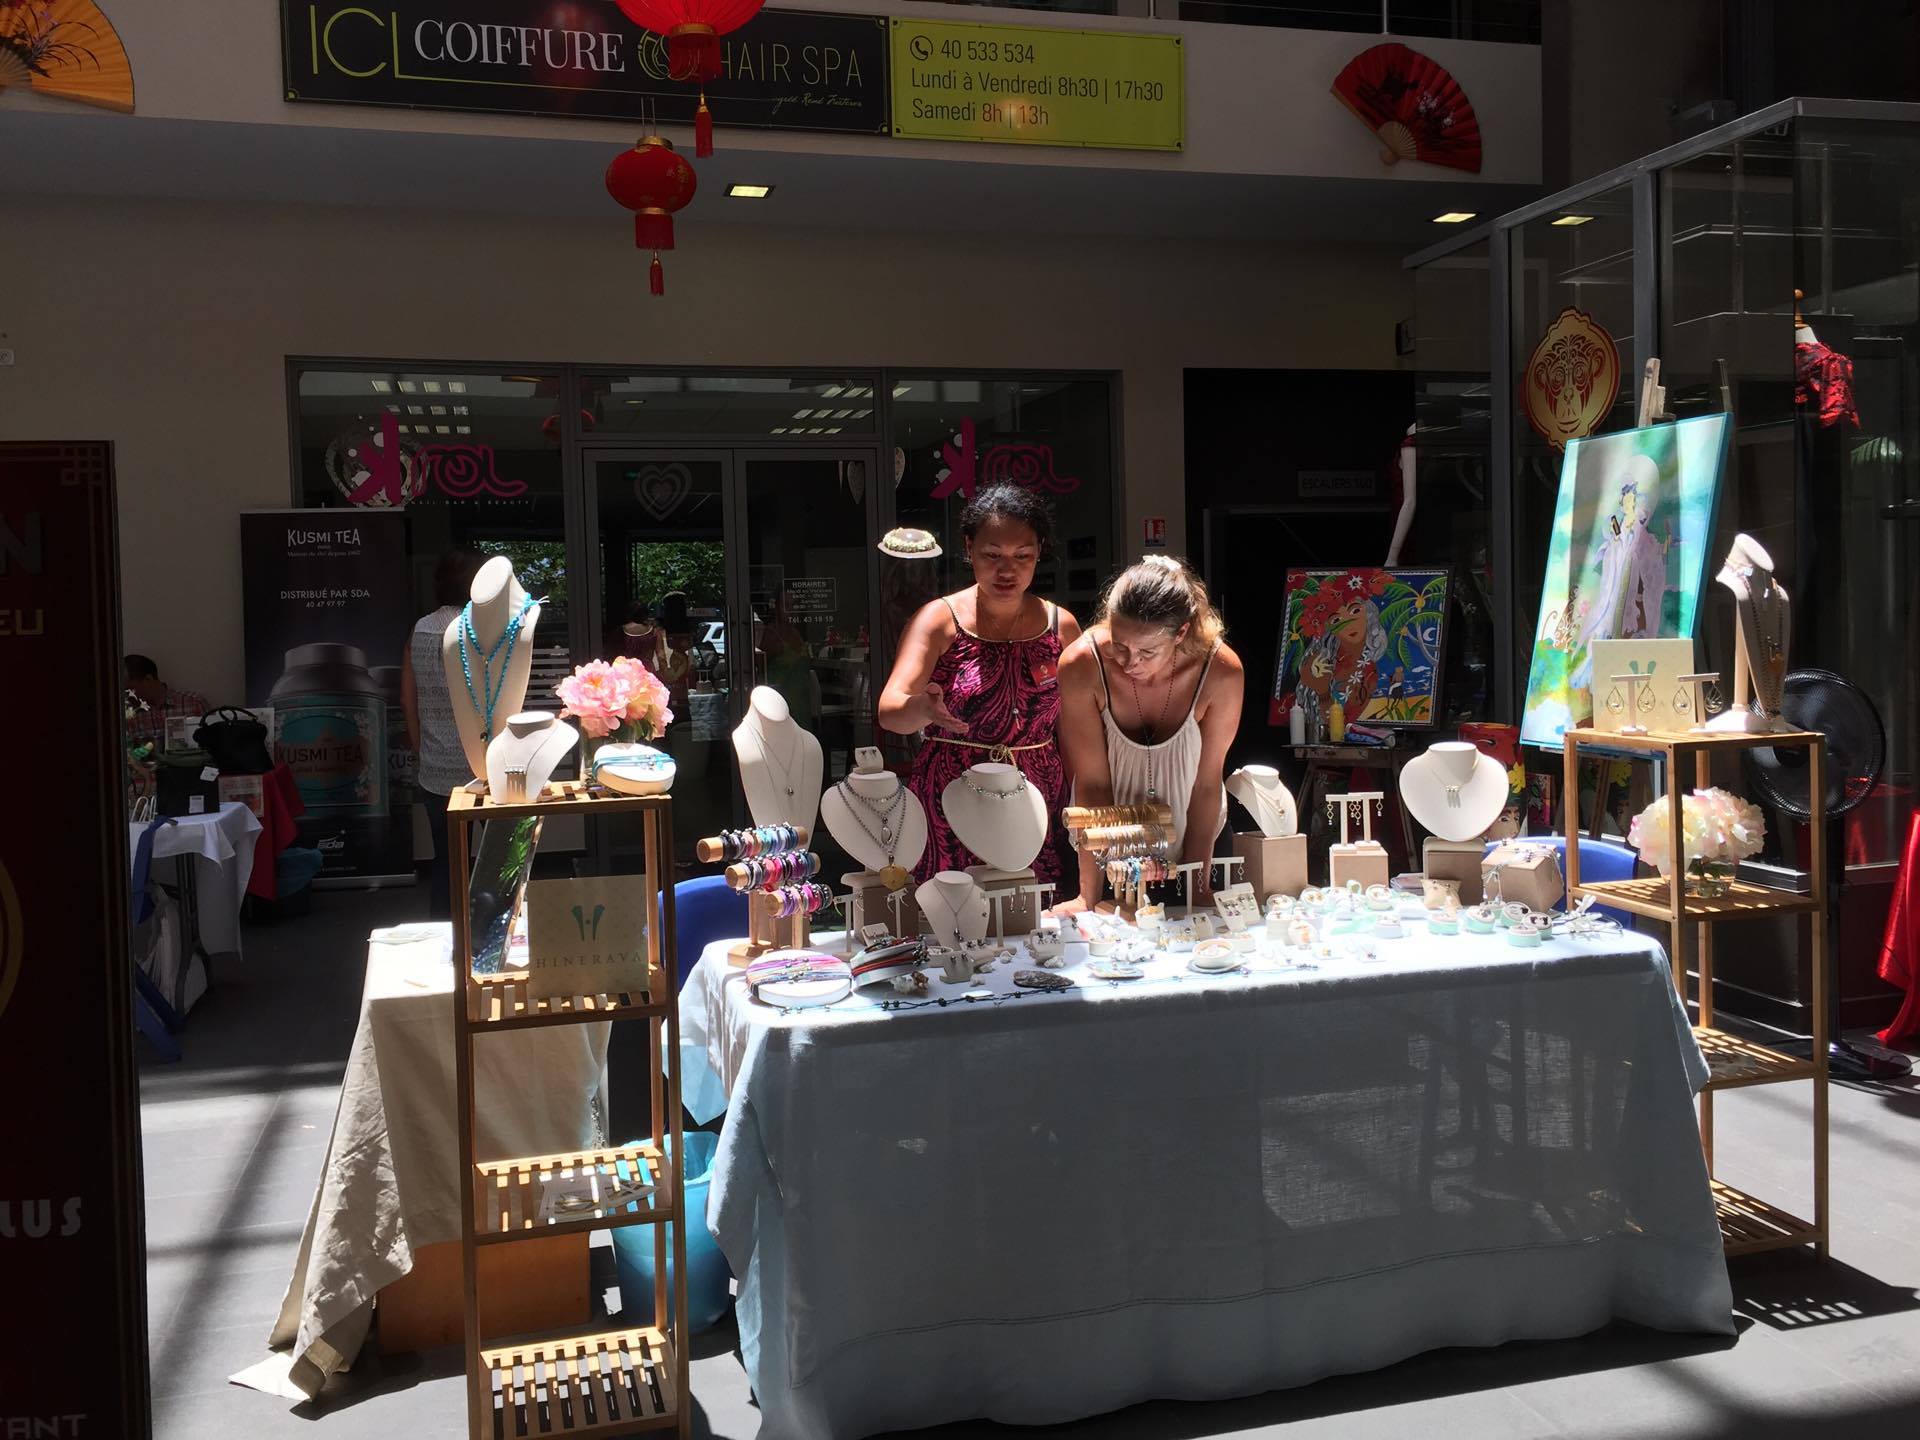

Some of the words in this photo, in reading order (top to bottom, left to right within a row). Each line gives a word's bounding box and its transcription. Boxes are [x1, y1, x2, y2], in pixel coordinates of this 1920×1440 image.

[413, 18, 625, 74] COIFFURE
[941, 39, 962, 60] 40
[967, 41, 998, 61] 533
[1004, 43, 1035, 63] 534
[720, 40, 792, 83] HAIR
[802, 44, 863, 88] SPA
[911, 68, 957, 90] Lundi
[963, 72, 973, 91] à
[978, 71, 1052, 96] Vendredi
[1058, 77, 1098, 98] 8h30
[1115, 80, 1164, 102] 17h30
[912, 98, 976, 121] Samedi
[982, 103, 1003, 123] 8h
[1019, 105, 1049, 125] 13h
[287, 528, 331, 547] KUSMI
[335, 528, 361, 546] TEA
[280, 588, 328, 599] DISTRIBUÉ
[330, 589, 349, 599] PAR
[350, 588, 370, 598] SDA
[276, 744, 328, 765] KUSMI
[332, 744, 364, 764] TEA
[0, 1413, 88, 1440] ANT
